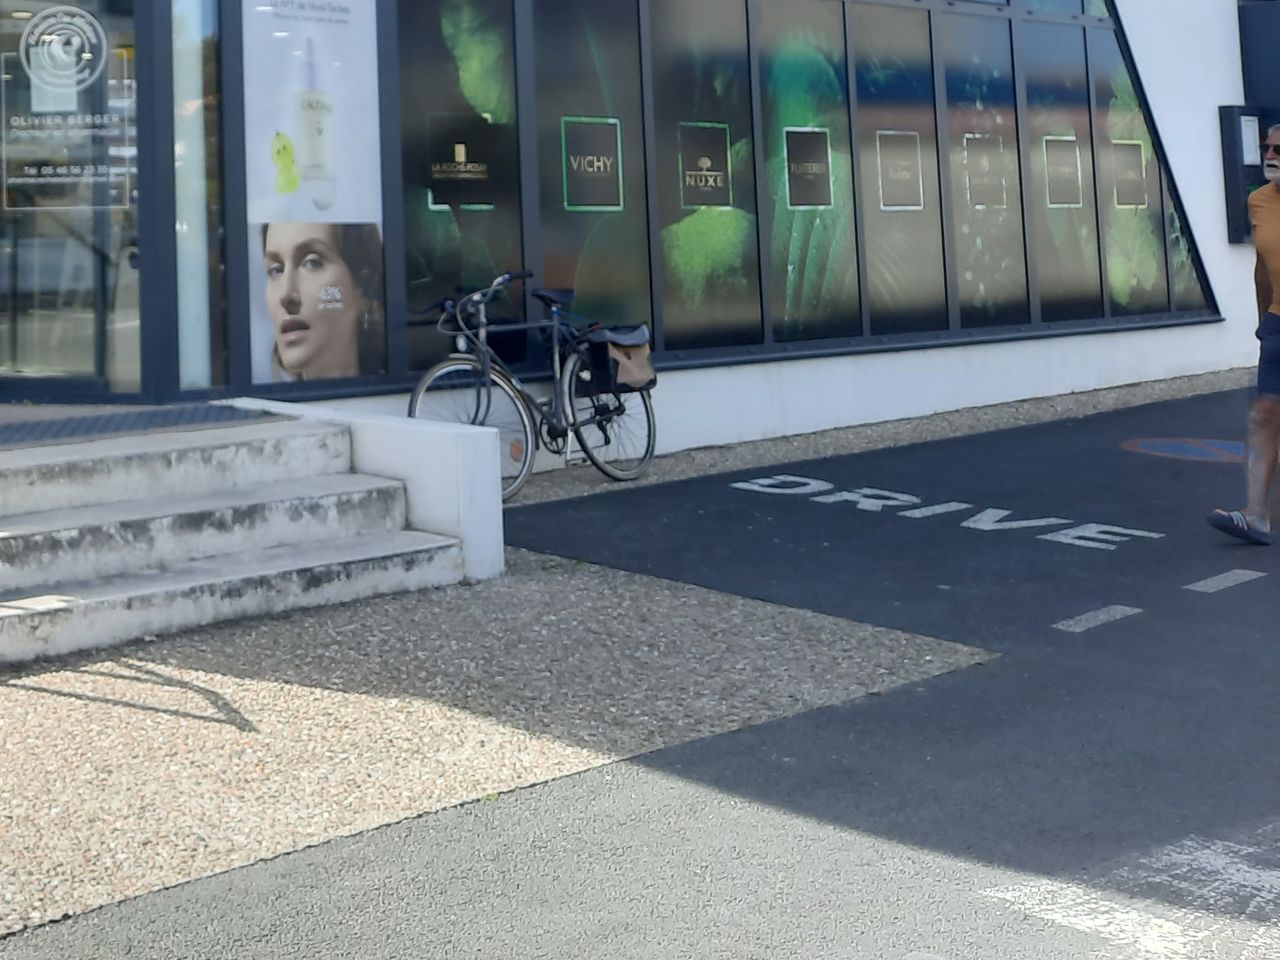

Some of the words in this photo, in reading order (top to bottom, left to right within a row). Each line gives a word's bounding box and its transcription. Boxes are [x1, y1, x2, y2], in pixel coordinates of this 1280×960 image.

[10, 115, 63, 126] OLIVIER
[67, 113, 120, 125] BERGER
[570, 155, 613, 173] VICHY
[685, 175, 724, 188] NUXE
[728, 474, 1166, 551] DRIVE
